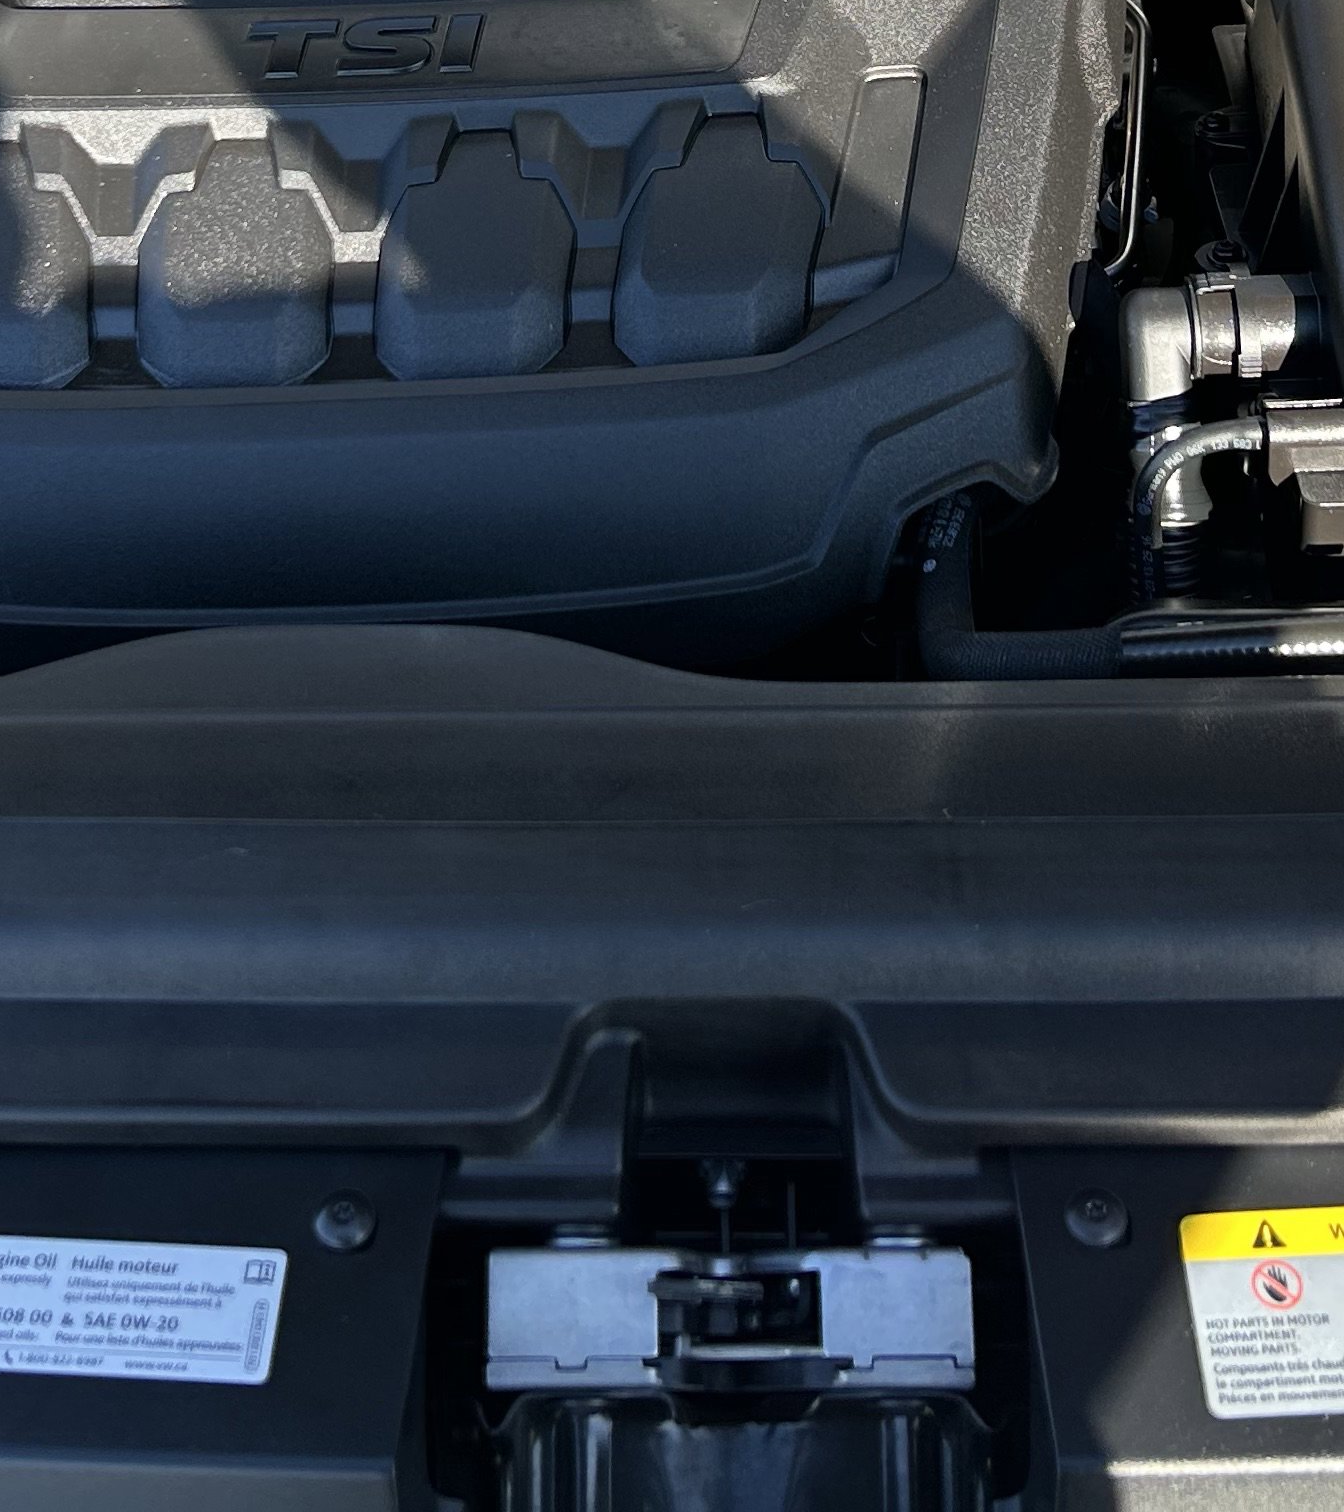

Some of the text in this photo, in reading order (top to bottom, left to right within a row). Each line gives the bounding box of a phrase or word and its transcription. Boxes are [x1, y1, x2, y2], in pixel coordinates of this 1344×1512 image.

[246, 13, 487, 80] TSI
[34, 1251, 58, 1269] Oil
[72, 1255, 114, 1272] Huile
[118, 1258, 180, 1275] moteur
[111, 1279, 182, 1293] uniquement
[186, 1281, 198, 1293] de
[63, 1291, 82, 1303] qui
[29, 1308, 54, 1327] 00
[61, 1312, 74, 1328] &
[85, 1311, 116, 1329] SAE
[120, 1313, 180, 1332] 0W-20
[1206, 1313, 1330, 1330] HOT PARTS IN MOTOR
[1210, 1342, 1301, 1357] MOVING PARTS.
[1213, 1361, 1285, 1376] Composants
[1216, 1377, 1227, 1389] le
[1230, 1375, 1317, 1391] compartiment
[1260, 1391, 1275, 1401] en
